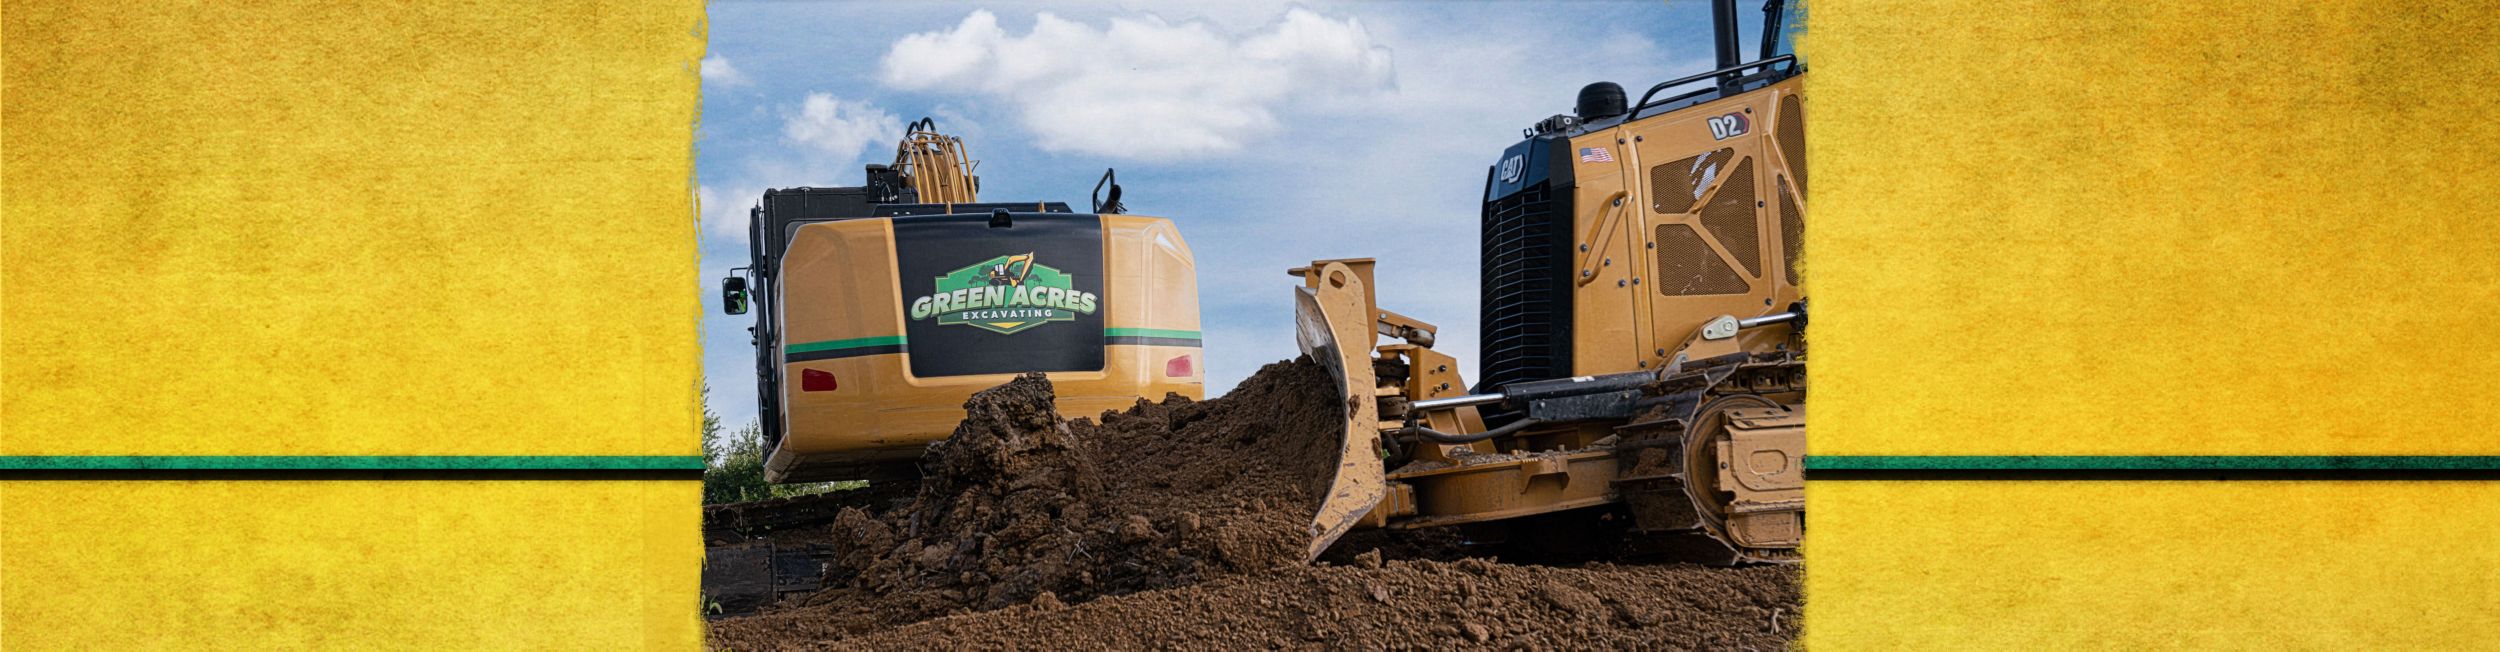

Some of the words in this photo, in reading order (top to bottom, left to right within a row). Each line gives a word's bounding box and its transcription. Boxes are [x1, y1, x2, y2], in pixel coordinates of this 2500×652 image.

[1710, 115, 1742, 140] D2
[1500, 154, 1522, 182] CAT
[911, 285, 1004, 320] GREEN
[1010, 285, 1097, 315] ACRES
[962, 309, 1053, 320] EXCAVATING
